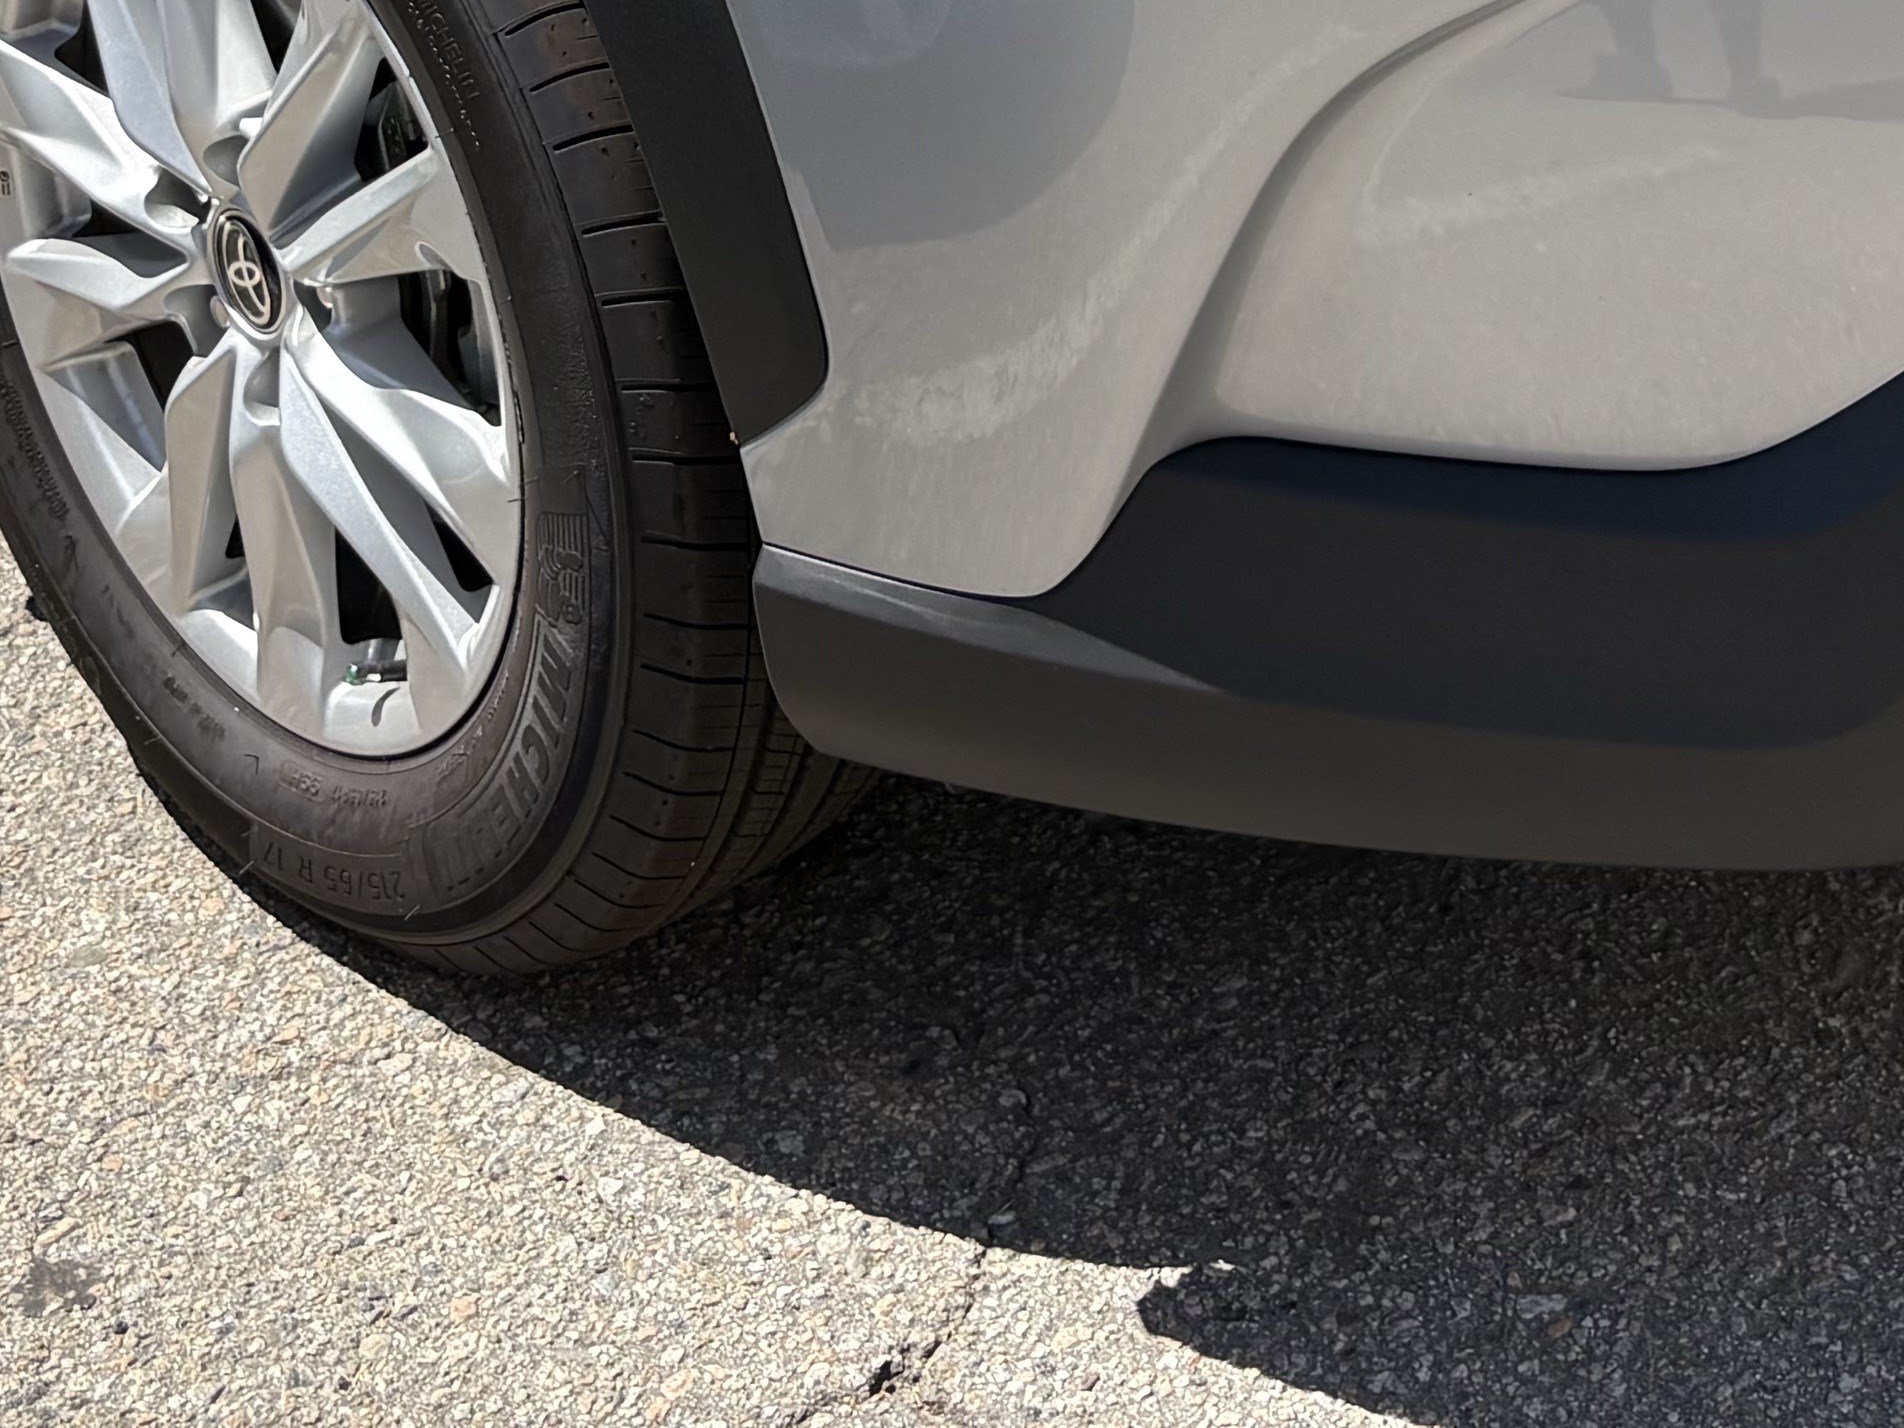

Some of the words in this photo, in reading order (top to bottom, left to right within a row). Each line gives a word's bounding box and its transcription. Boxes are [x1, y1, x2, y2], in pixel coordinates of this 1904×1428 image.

[263, 841, 283, 871] 17
[299, 856, 313, 883] R
[323, 866, 408, 900] 215/65
